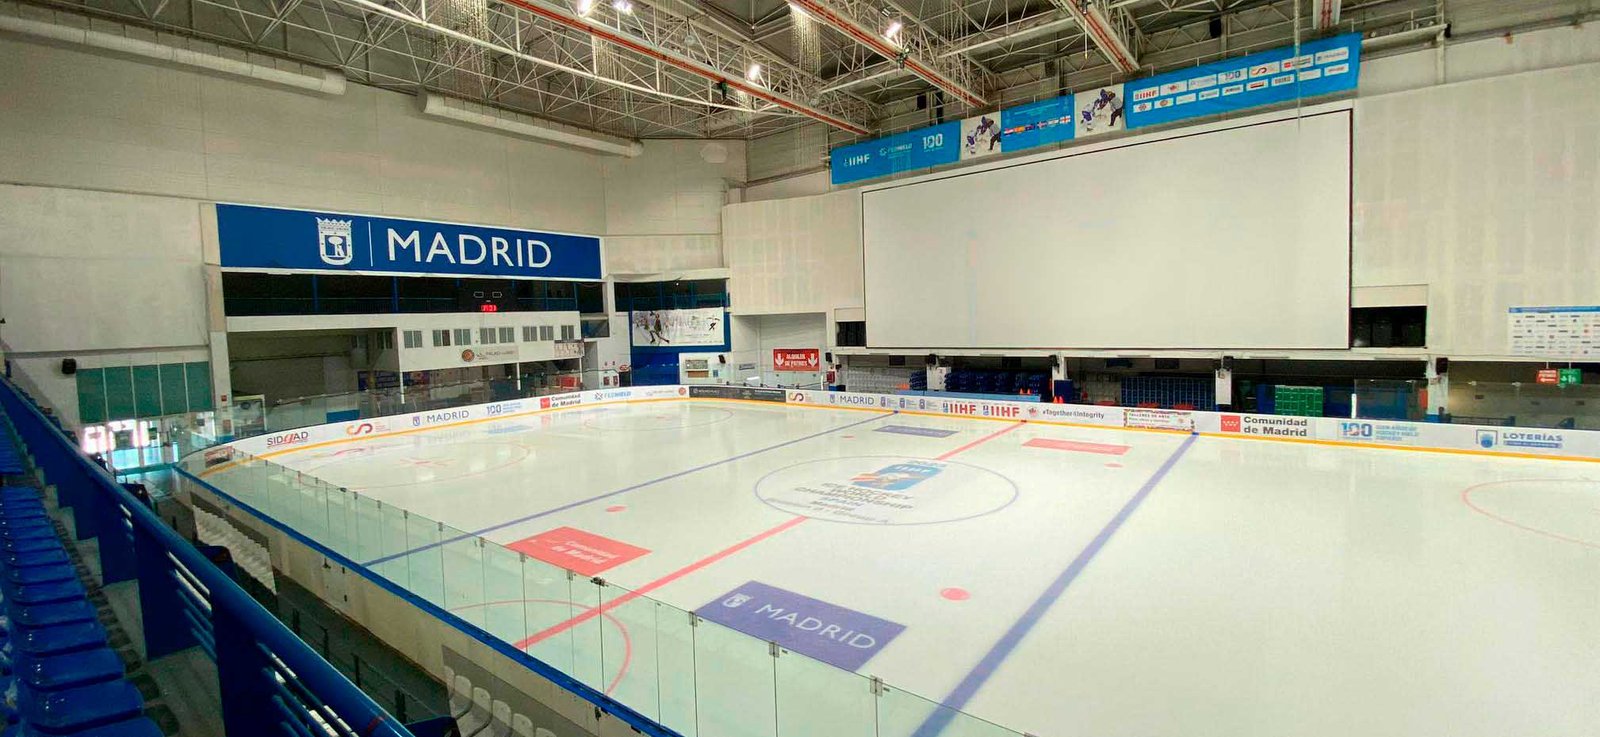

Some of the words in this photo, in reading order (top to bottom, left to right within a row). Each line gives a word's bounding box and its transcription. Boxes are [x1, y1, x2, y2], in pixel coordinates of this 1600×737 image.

[922, 133, 943, 149] 100
[849, 153, 870, 166] IIHF
[386, 227, 552, 269] MADRID
[551, 394, 581, 402] Comunidad
[840, 395, 874, 405] MADRID
[950, 403, 977, 415] IIHF
[991, 405, 1020, 417] IIHF
[427, 410, 469, 423] MADRID
[1244, 416, 1308, 427] Comunidad
[1244, 426, 1259, 434] de
[1262, 427, 1308, 437] Madrid
[1341, 422, 1373, 437] 100
[1503, 432, 1563, 441] LOTERÍAS
[754, 603, 877, 649] MADRID
